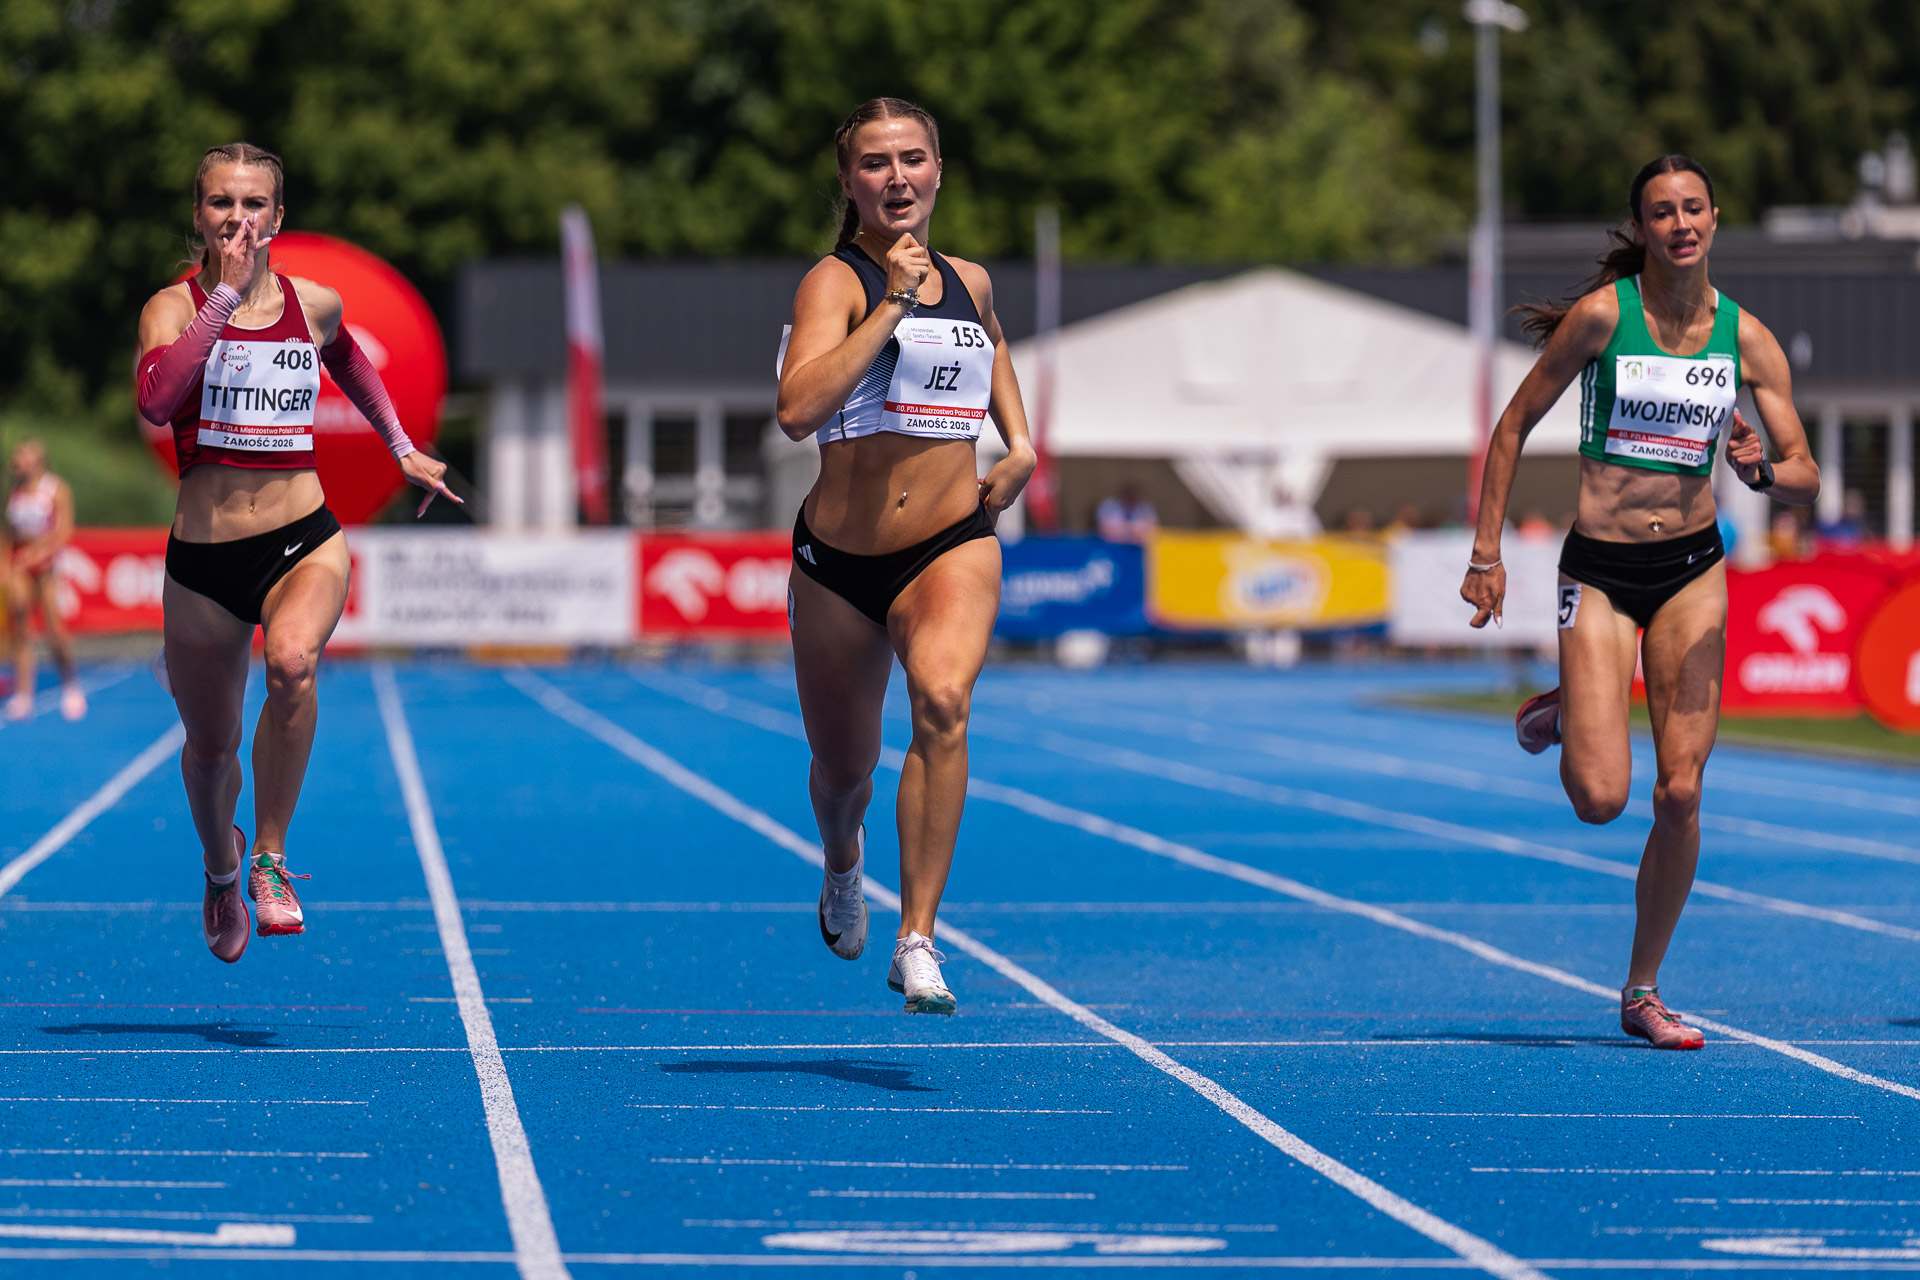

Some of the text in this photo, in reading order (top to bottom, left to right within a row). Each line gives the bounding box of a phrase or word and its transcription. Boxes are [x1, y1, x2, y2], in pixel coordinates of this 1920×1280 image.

[951, 326, 985, 348] 155
[272, 349, 313, 370] 408
[924, 361, 962, 391] JEŻ
[1686, 366, 1727, 388] 696
[208, 385, 313, 412] TITTINGER
[896, 405, 984, 418] 80. PZLA Mistrzostwa Polski U20
[1620, 398, 1726, 428] WOJEŃSKA
[210, 422, 222, 430] 80.
[222, 423, 239, 432] PZLA
[239, 426, 278, 435] Mistrzostwa
[906, 417, 971, 431] ZAMOŚĆ 2026
[223, 436, 294, 448] ZAMOŚĆ 2026
[1618, 431, 1629, 439] 80.
[1630, 432, 1647, 441] PZLA
[1647, 434, 1689, 448] Mistrzostwa
[1631, 444, 1679, 459] ZAMOŚĆ
[1559, 588, 1575, 625] 5
